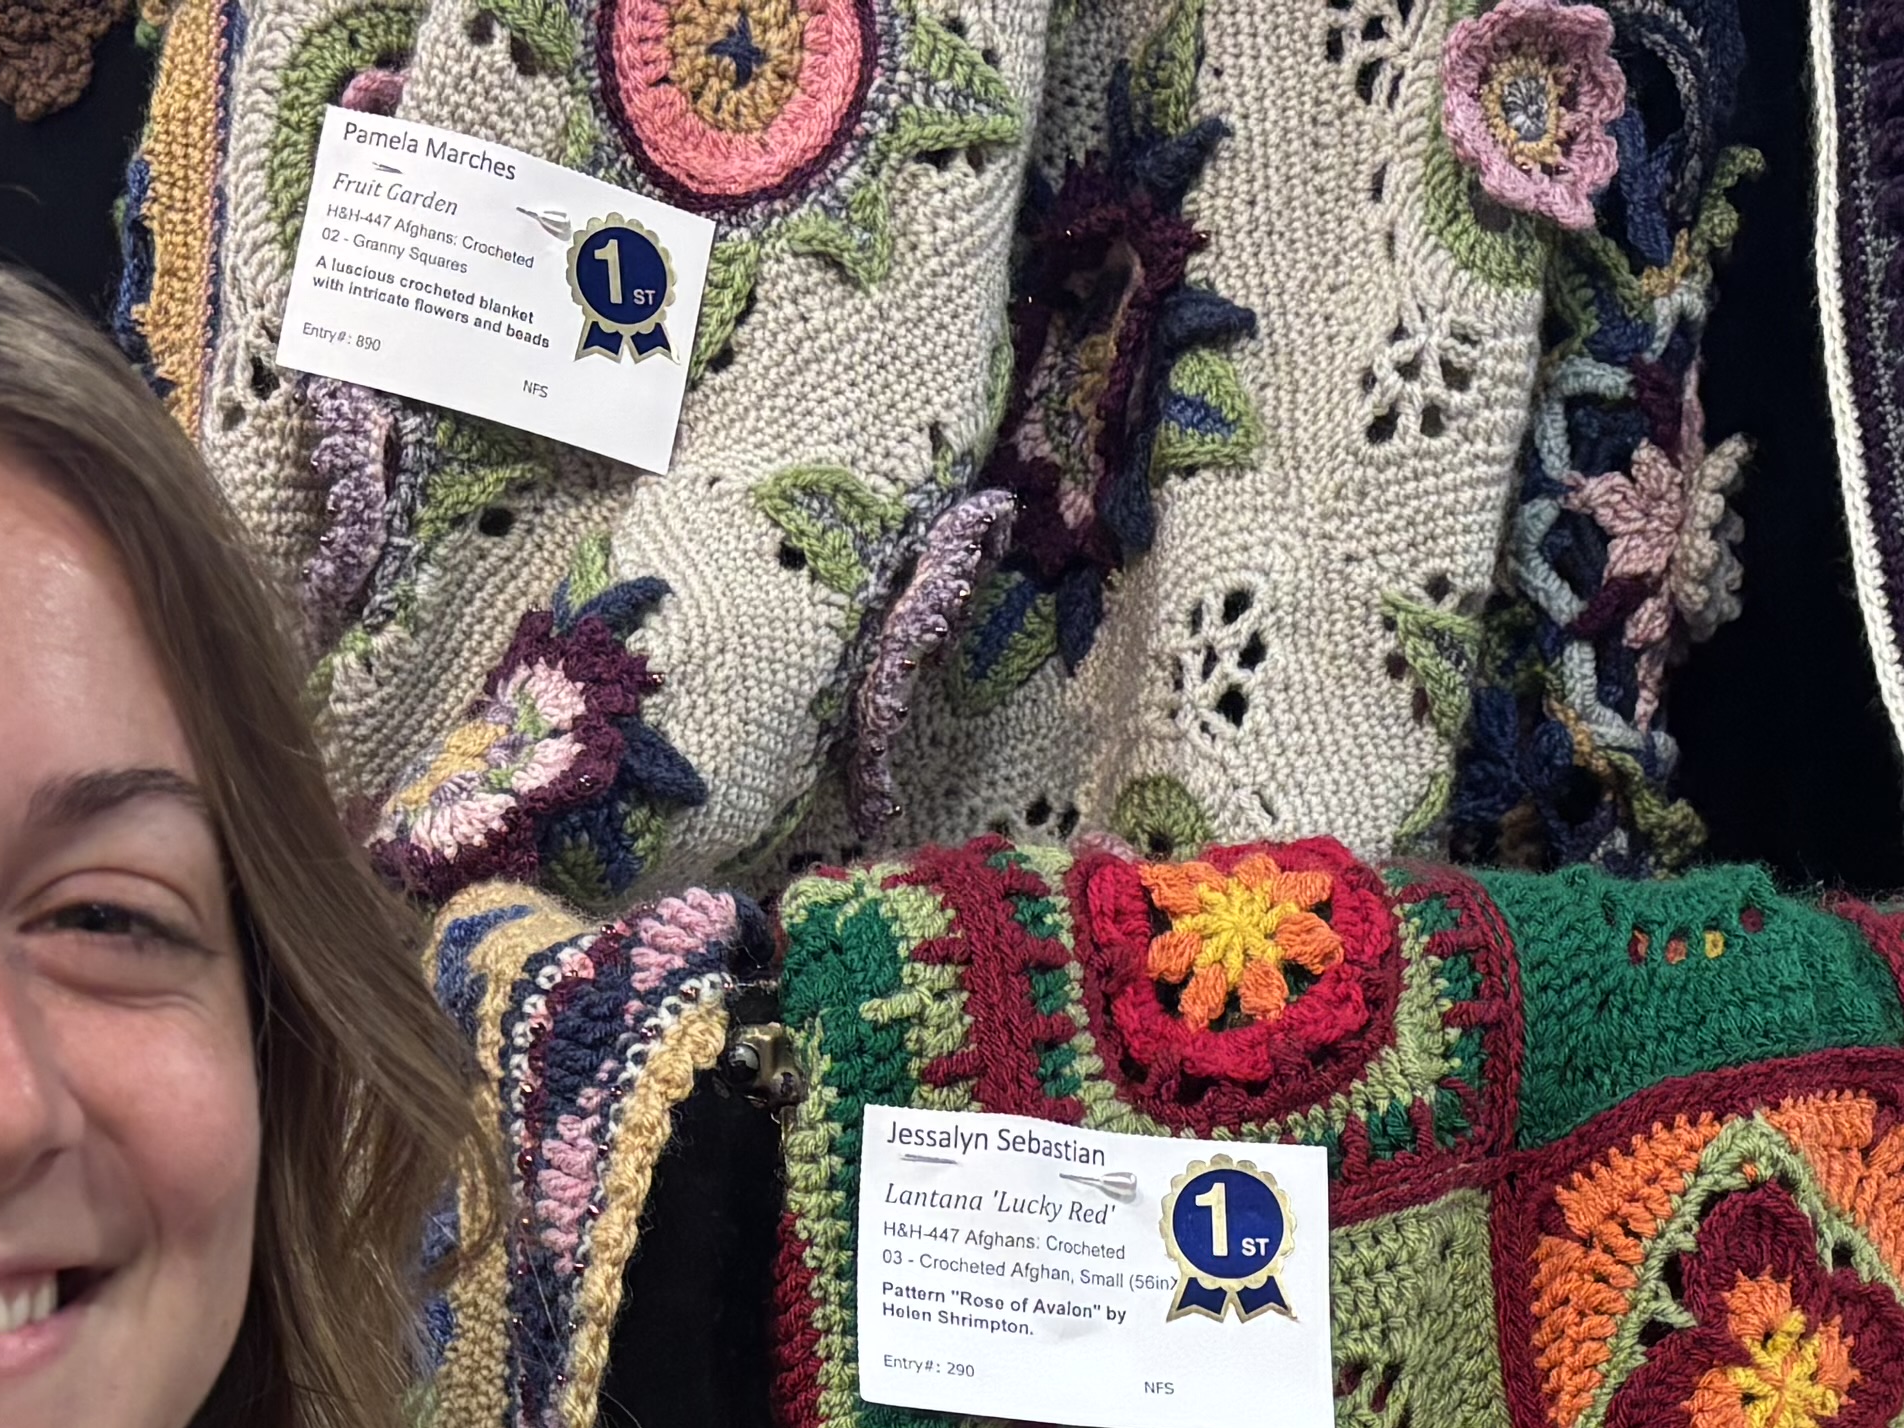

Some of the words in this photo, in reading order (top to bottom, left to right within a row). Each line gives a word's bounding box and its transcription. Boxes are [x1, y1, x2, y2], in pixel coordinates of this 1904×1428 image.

[342, 120, 419, 154] Pamela
[425, 137, 516, 181] Marches
[332, 171, 383, 197] Fruit
[386, 182, 458, 216] Garden
[321, 226, 341, 243] 02
[352, 233, 406, 260] Granny
[408, 245, 468, 274] Squares
[326, 203, 393, 228] H&H-447
[393, 217, 458, 246] Afghans:
[461, 235, 535, 269] Crocheted
[315, 254, 327, 269] A
[331, 257, 395, 285] luscious
[399, 276, 476, 306] crocheted
[478, 295, 534, 325] blanket
[312, 276, 344, 292] with
[347, 281, 410, 308] intricate
[414, 297, 469, 324] flowers
[472, 316, 503, 334] and
[505, 322, 550, 349] beads
[355, 333, 381, 352] 890
[522, 379, 549, 399] NFS
[886, 1120, 988, 1155] Jessalyn
[996, 1127, 1105, 1167] Sebastian
[884, 1182, 983, 1211] Lantana
[993, 1189, 1063, 1223] 'Lucky
[1068, 1200, 1116, 1225] Red'
[883, 1220, 960, 1243] H&H-447
[964, 1228, 1040, 1251] Afghans:
[1045, 1234, 1125, 1260] Crocheted
[882, 1248, 903, 1265] 03
[919, 1252, 1006, 1277] Crocheted
[1009, 1261, 1074, 1285] Afghan,
[1079, 1268, 1124, 1288] Small
[881, 1280, 945, 1303] Pattern
[950, 1289, 1004, 1311] "Rose
[1009, 1297, 1029, 1313] of
[1032, 1298, 1101, 1319] Avalon"
[1105, 1305, 1127, 1325] by
[882, 1301, 932, 1322] Helen
[937, 1309, 1034, 1336] Shrimpton.
[883, 1353, 941, 1374] Entry#:
[946, 1361, 975, 1378] 290
[1143, 1380, 1175, 1395] NFS
